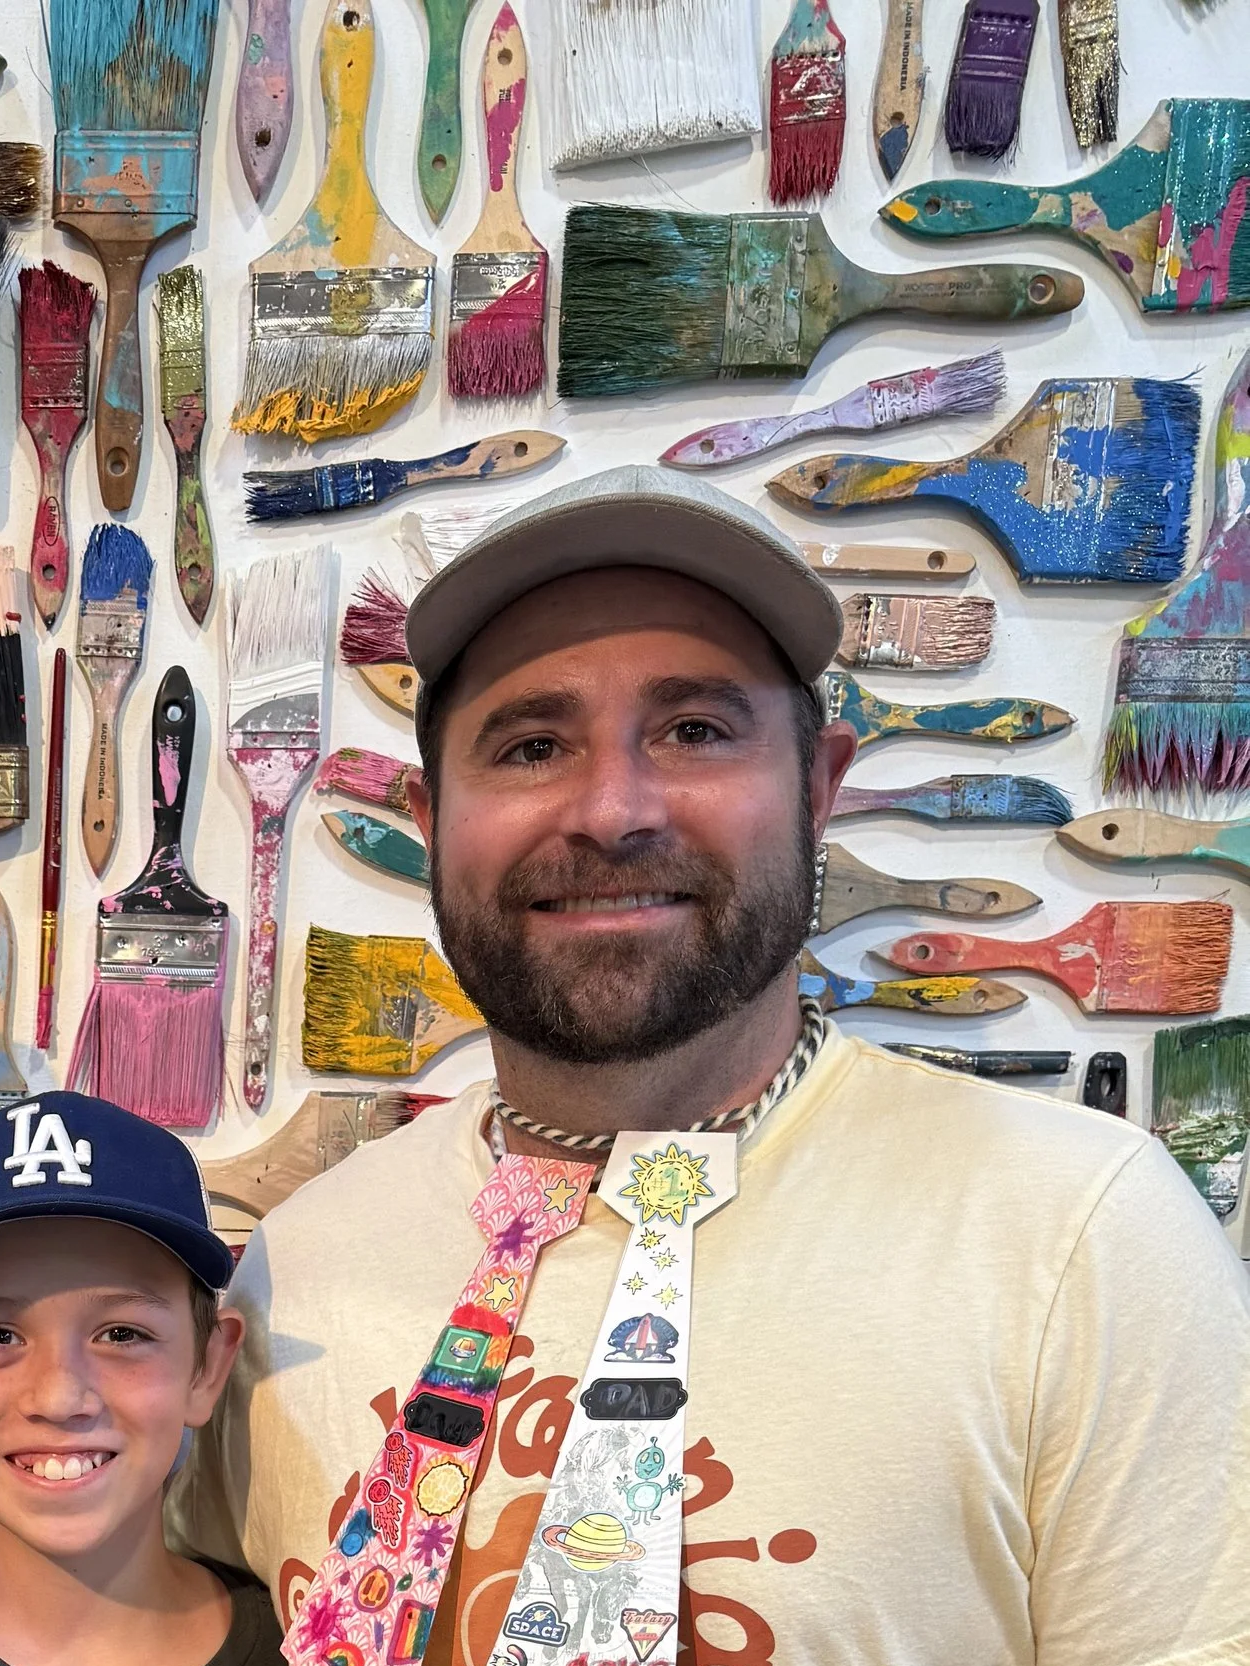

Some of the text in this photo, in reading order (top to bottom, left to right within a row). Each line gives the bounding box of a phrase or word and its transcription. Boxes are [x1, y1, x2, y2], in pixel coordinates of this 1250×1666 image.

[904, 2, 914, 29] MADE
[899, 41, 911, 92] INDONESIA
[948, 282, 972, 291] PRO
[46, 505, 57, 538] RAVEN
[100, 723, 108, 746] MADE
[4, 1102, 92, 1188] LA
[600, 1382, 679, 1418] DAD
[511, 1620, 562, 1640] SPACE
